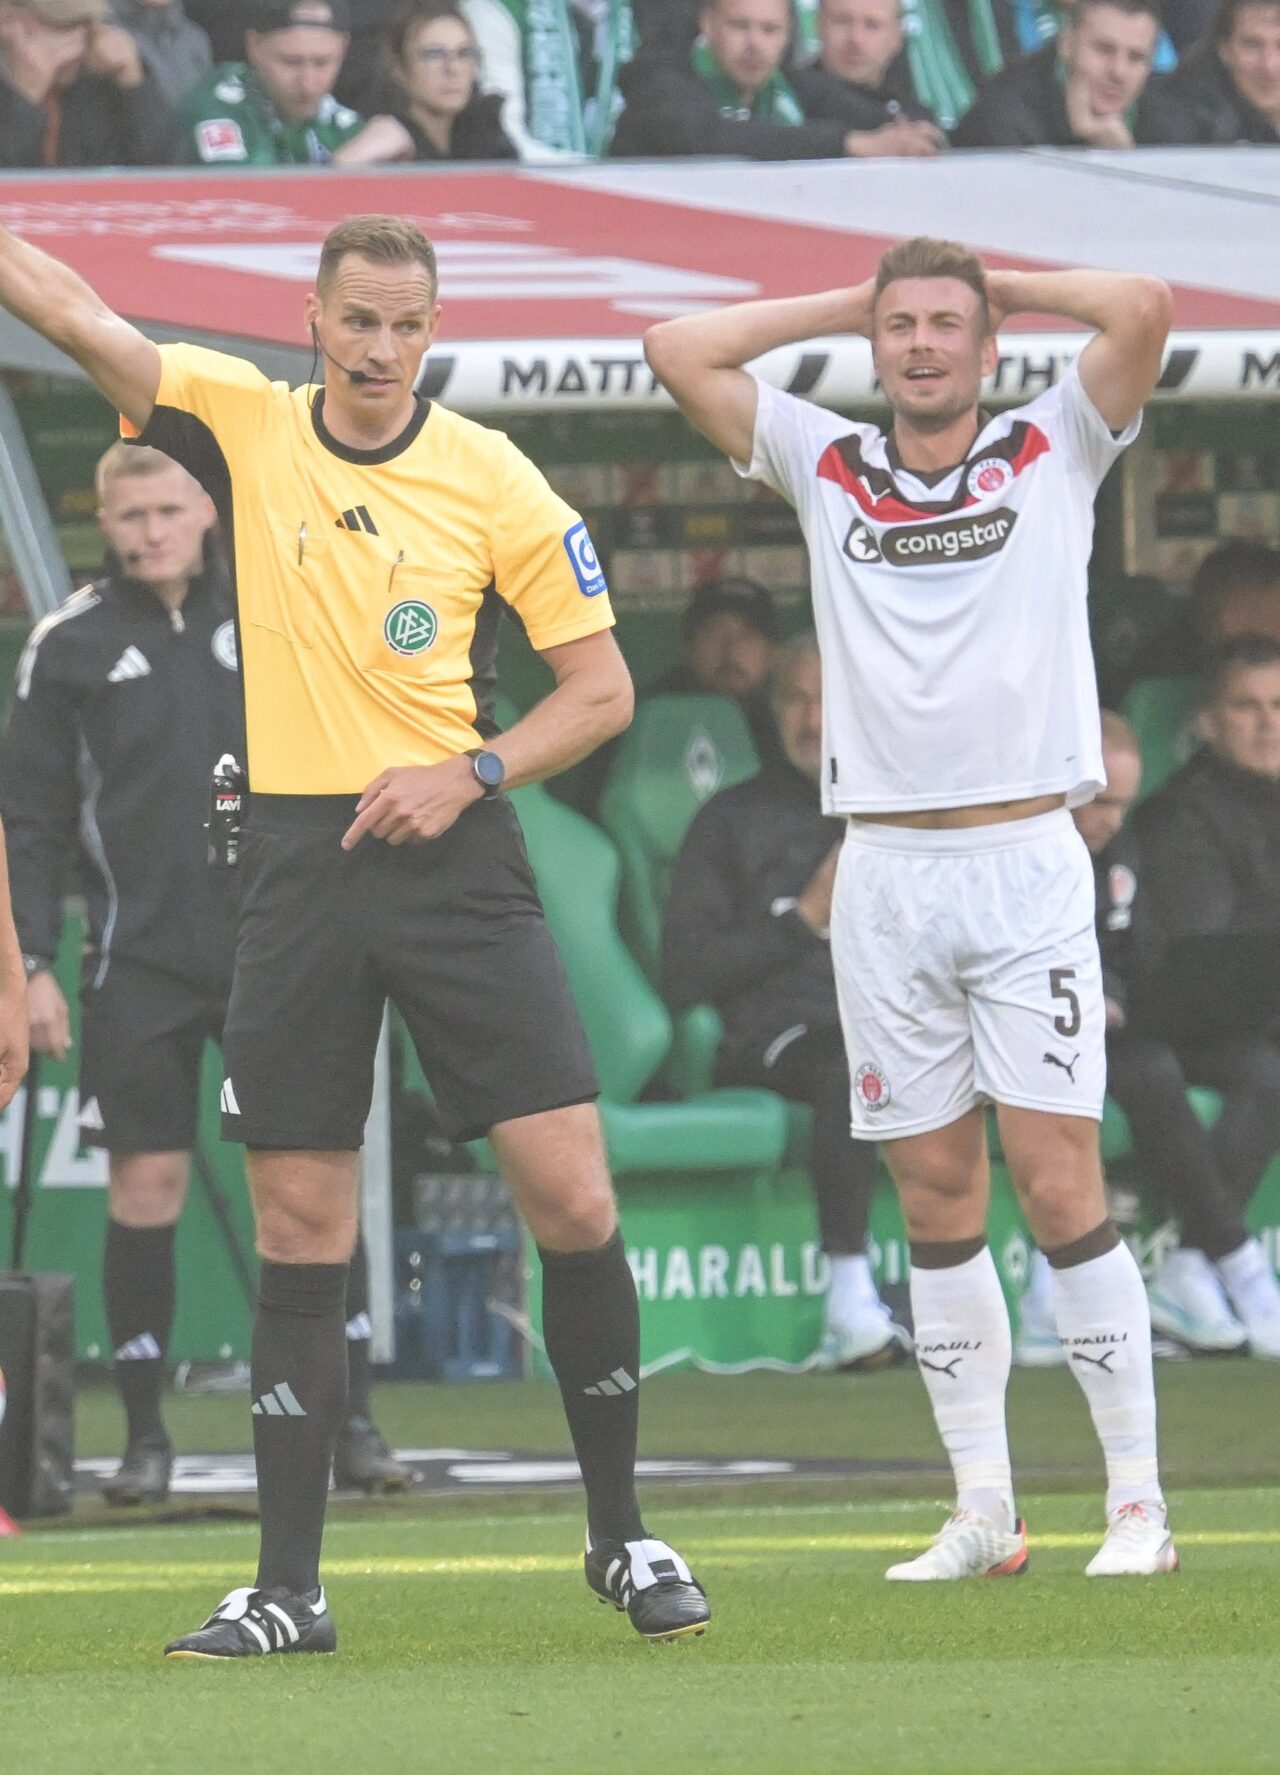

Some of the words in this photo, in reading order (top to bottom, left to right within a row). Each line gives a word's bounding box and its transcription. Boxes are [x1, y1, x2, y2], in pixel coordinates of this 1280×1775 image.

[503, 359, 658, 392] MATT
[895, 519, 1009, 556] congstar
[216, 796, 240, 811] LAVI
[1049, 969, 1081, 1037] 5
[625, 1241, 832, 1300] HARALD
